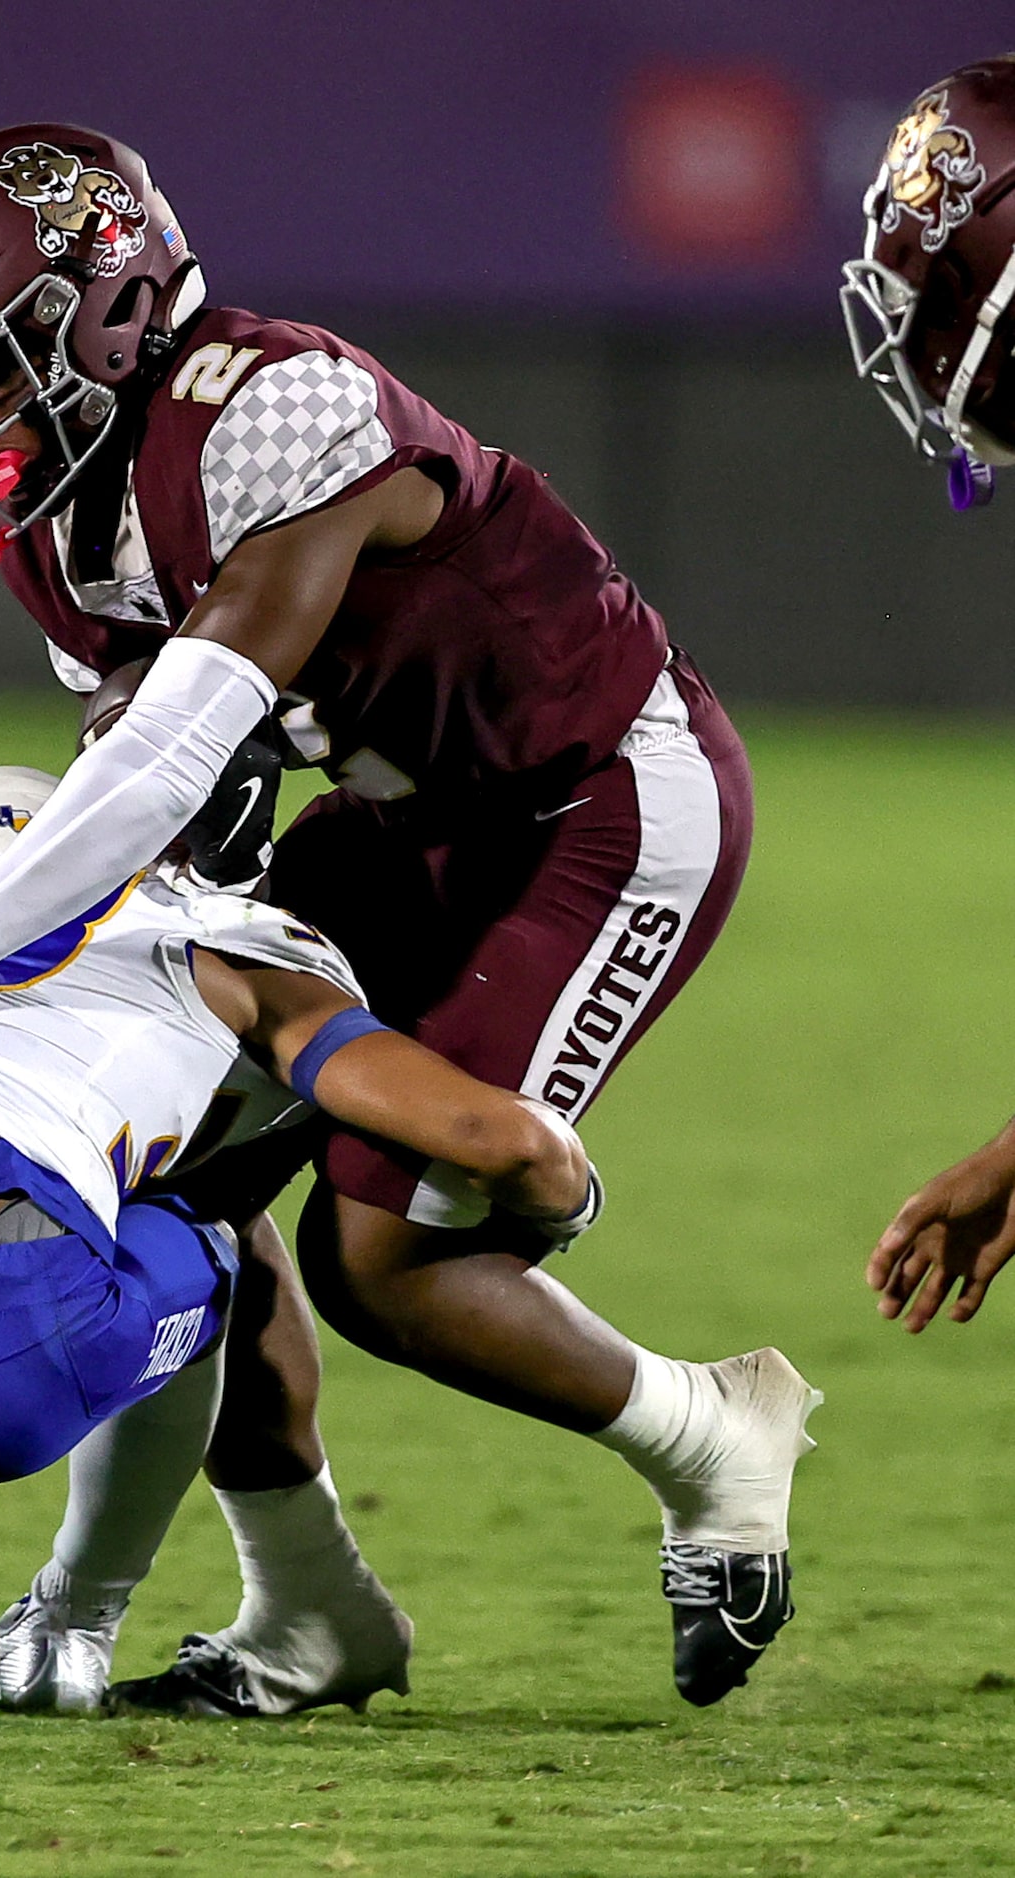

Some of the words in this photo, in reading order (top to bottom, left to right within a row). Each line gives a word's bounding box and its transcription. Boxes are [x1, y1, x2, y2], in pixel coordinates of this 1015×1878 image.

[47, 352, 61, 385] dell
[172, 343, 264, 405] 2
[541, 901, 681, 1118] OYOTES
